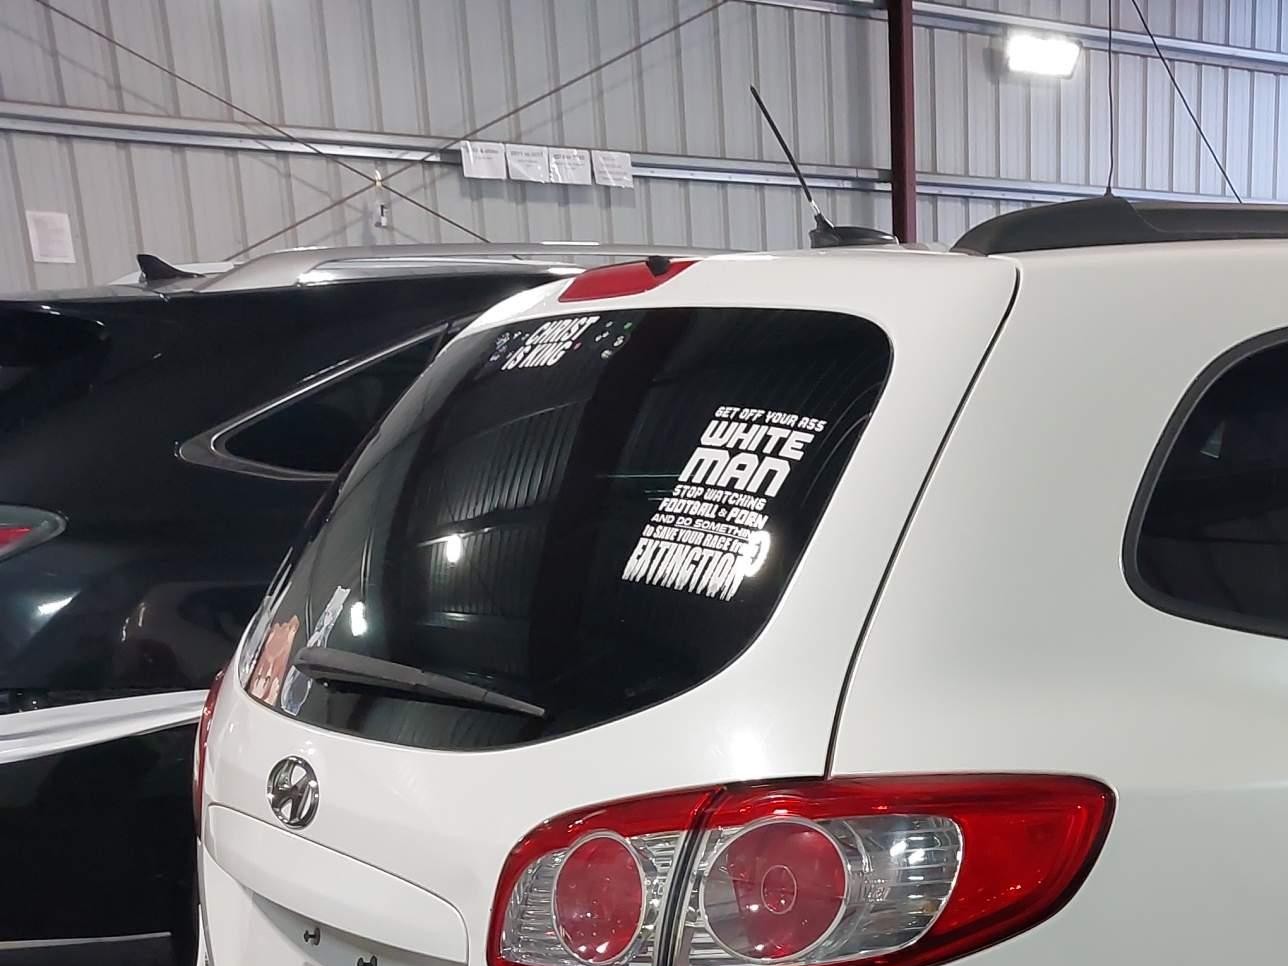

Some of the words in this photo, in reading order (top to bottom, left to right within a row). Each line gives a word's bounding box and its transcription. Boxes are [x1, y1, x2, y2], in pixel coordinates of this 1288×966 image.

[525, 315, 600, 345] CHRIST
[501, 345, 532, 370] IS
[518, 340, 573, 369] KING
[715, 406, 740, 419] GET
[740, 409, 765, 421] OFF
[766, 411, 799, 427] YOUR
[798, 415, 828, 432] ASS
[700, 419, 815, 461] WHITE
[678, 446, 791, 498] MAN
[672, 484, 705, 498] STOP
[704, 487, 767, 511] WATCHING
[651, 513, 676, 525] AND
[675, 516, 692, 527] DO
[693, 519, 758, 539] SOMETHIN
[658, 497, 721, 519] FOOTBALL
[718, 507, 728, 517] &
[726, 508, 769, 530] PORN
[642, 524, 653, 537] to
[653, 526, 678, 541] SAVE
[677, 528, 704, 545] YOUR
[702, 533, 732, 551] RACE
[621, 537, 747, 602] EXTINCTION
